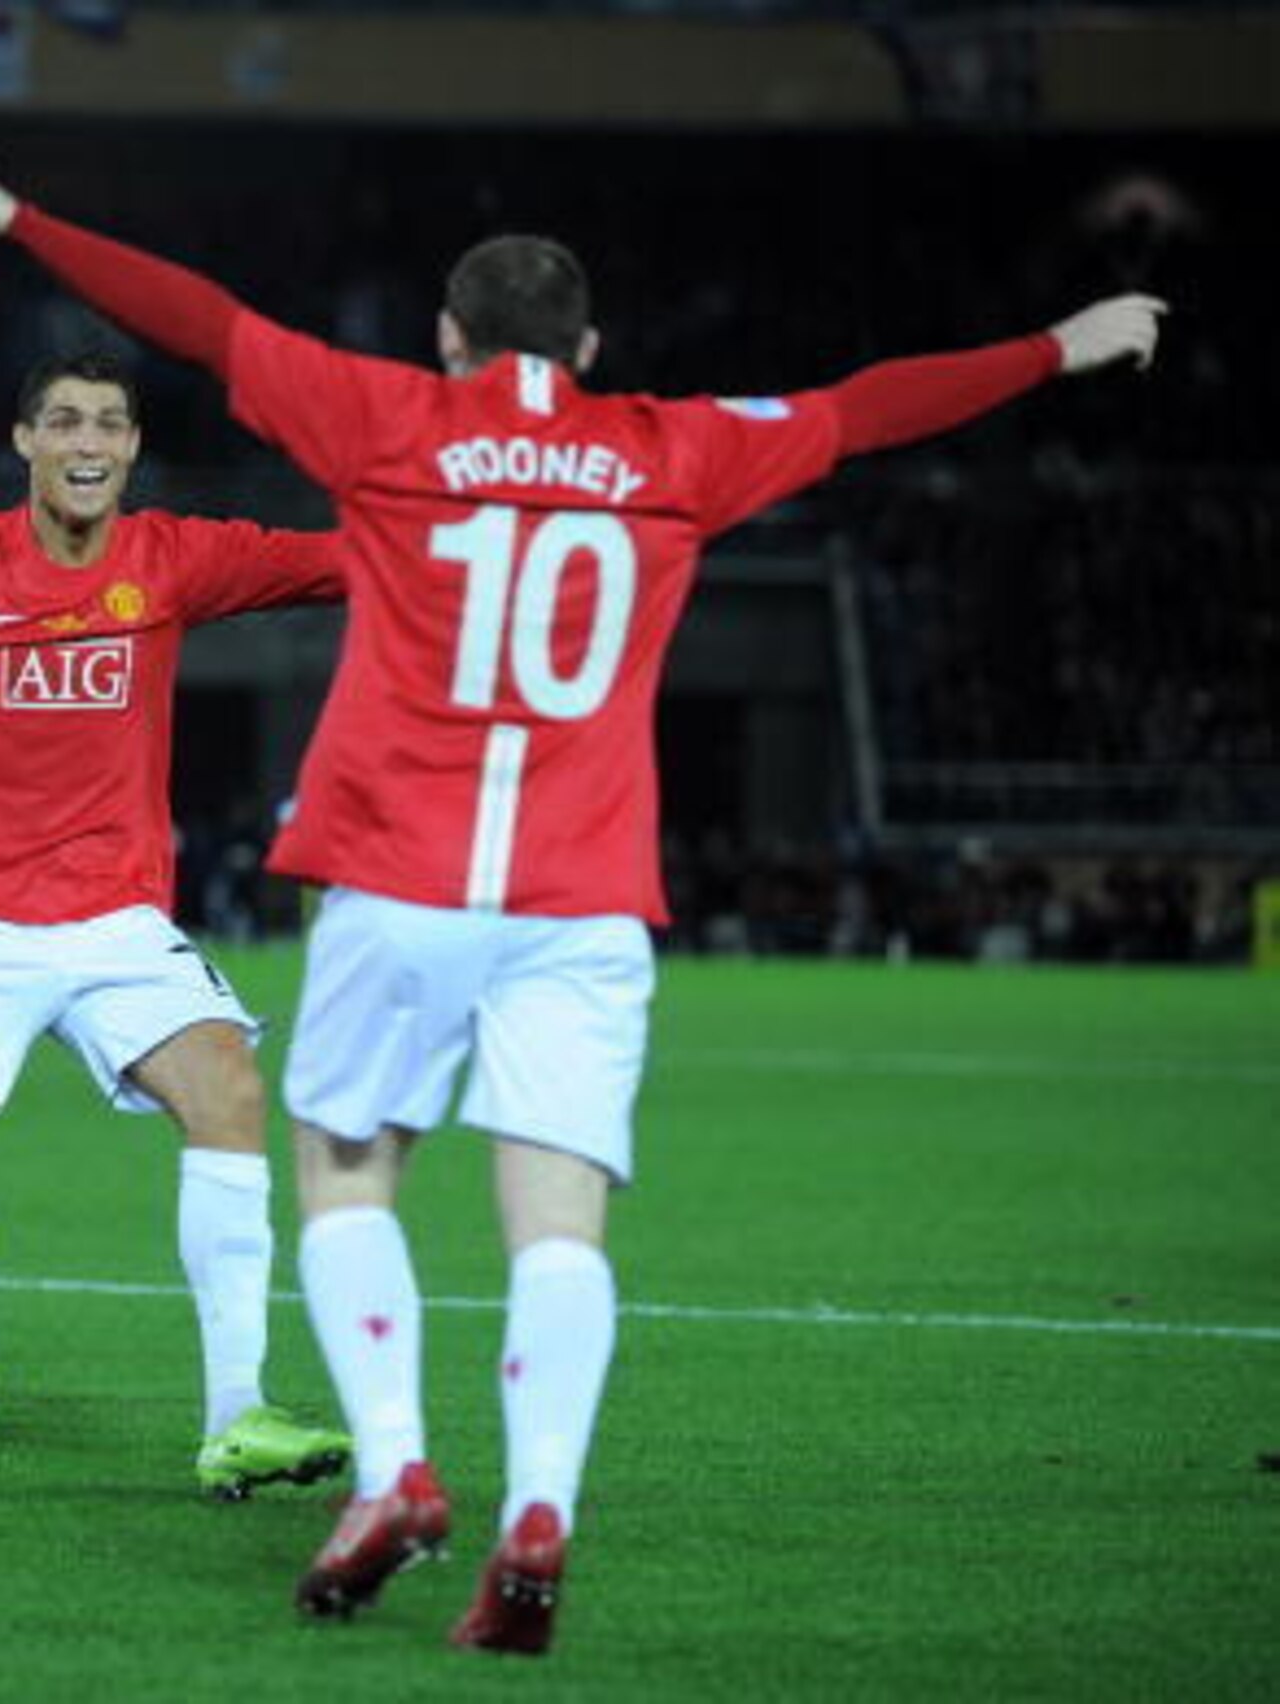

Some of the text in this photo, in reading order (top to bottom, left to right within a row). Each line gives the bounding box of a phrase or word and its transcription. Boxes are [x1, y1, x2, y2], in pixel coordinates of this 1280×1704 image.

[436, 437, 646, 504] ROONEY
[429, 503, 638, 720] 10
[10, 646, 124, 701] AIG
